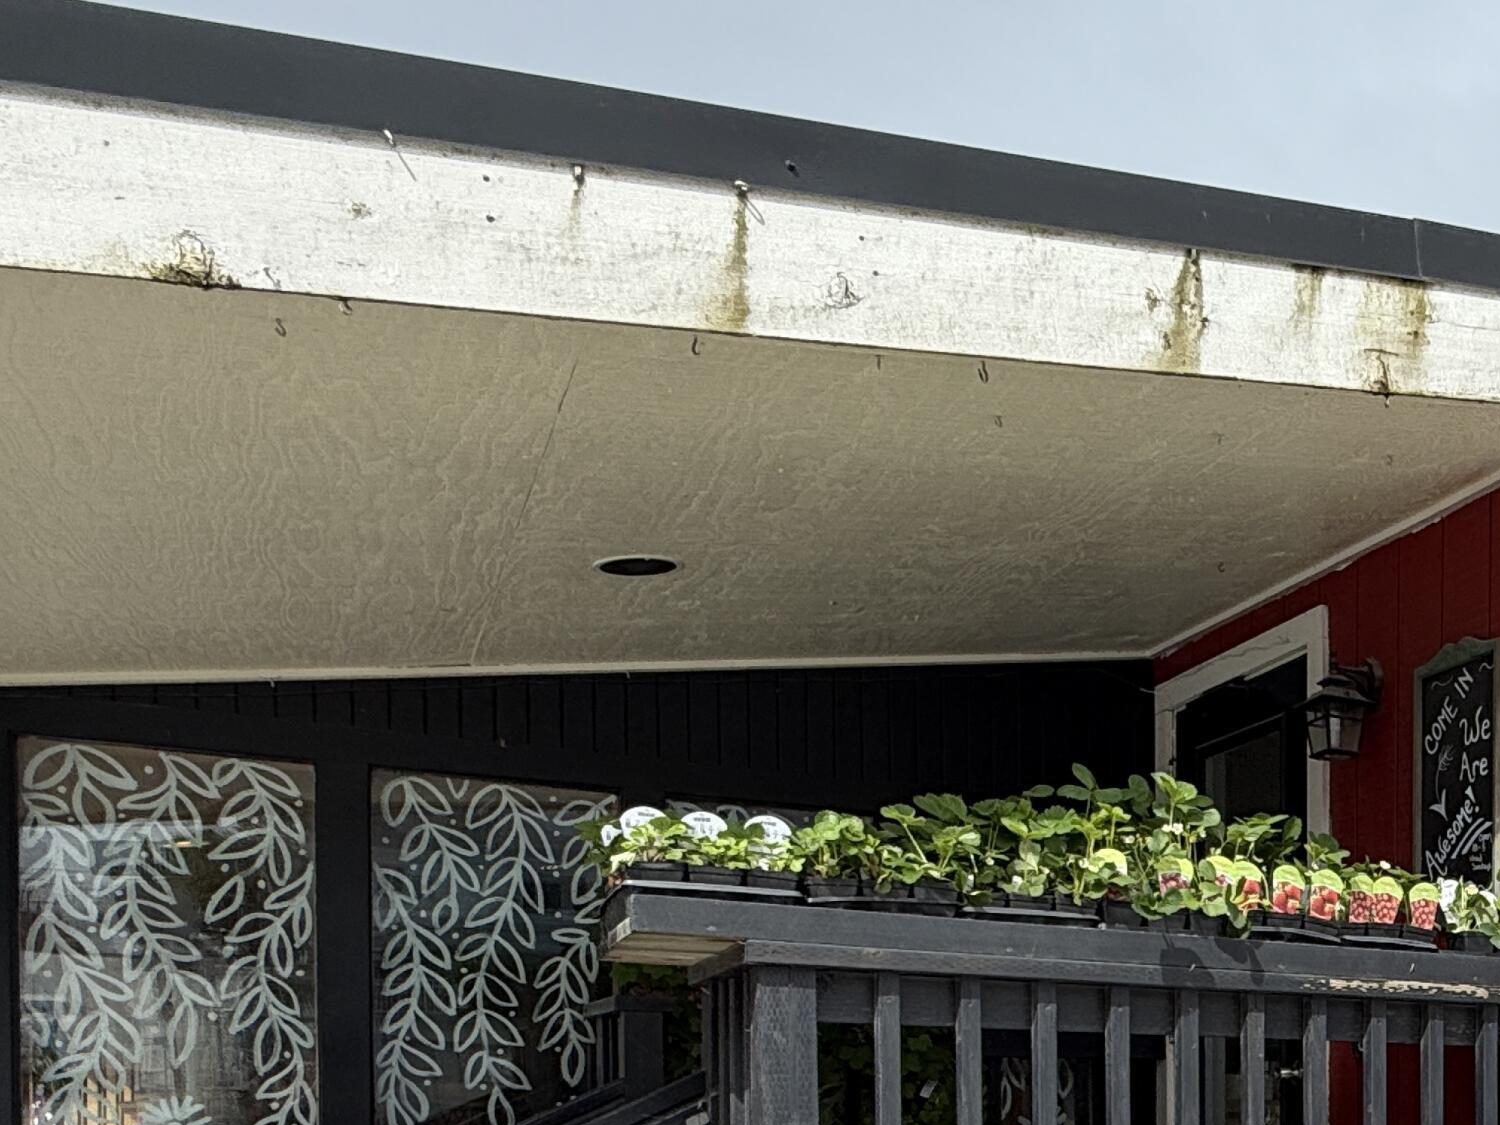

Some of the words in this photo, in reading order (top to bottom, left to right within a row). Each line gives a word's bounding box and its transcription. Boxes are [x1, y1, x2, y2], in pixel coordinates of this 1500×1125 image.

[1424, 696, 1459, 756] COME
[1453, 667, 1475, 699] IN
[1459, 705, 1492, 746] We
[1459, 755, 1489, 783] Are
